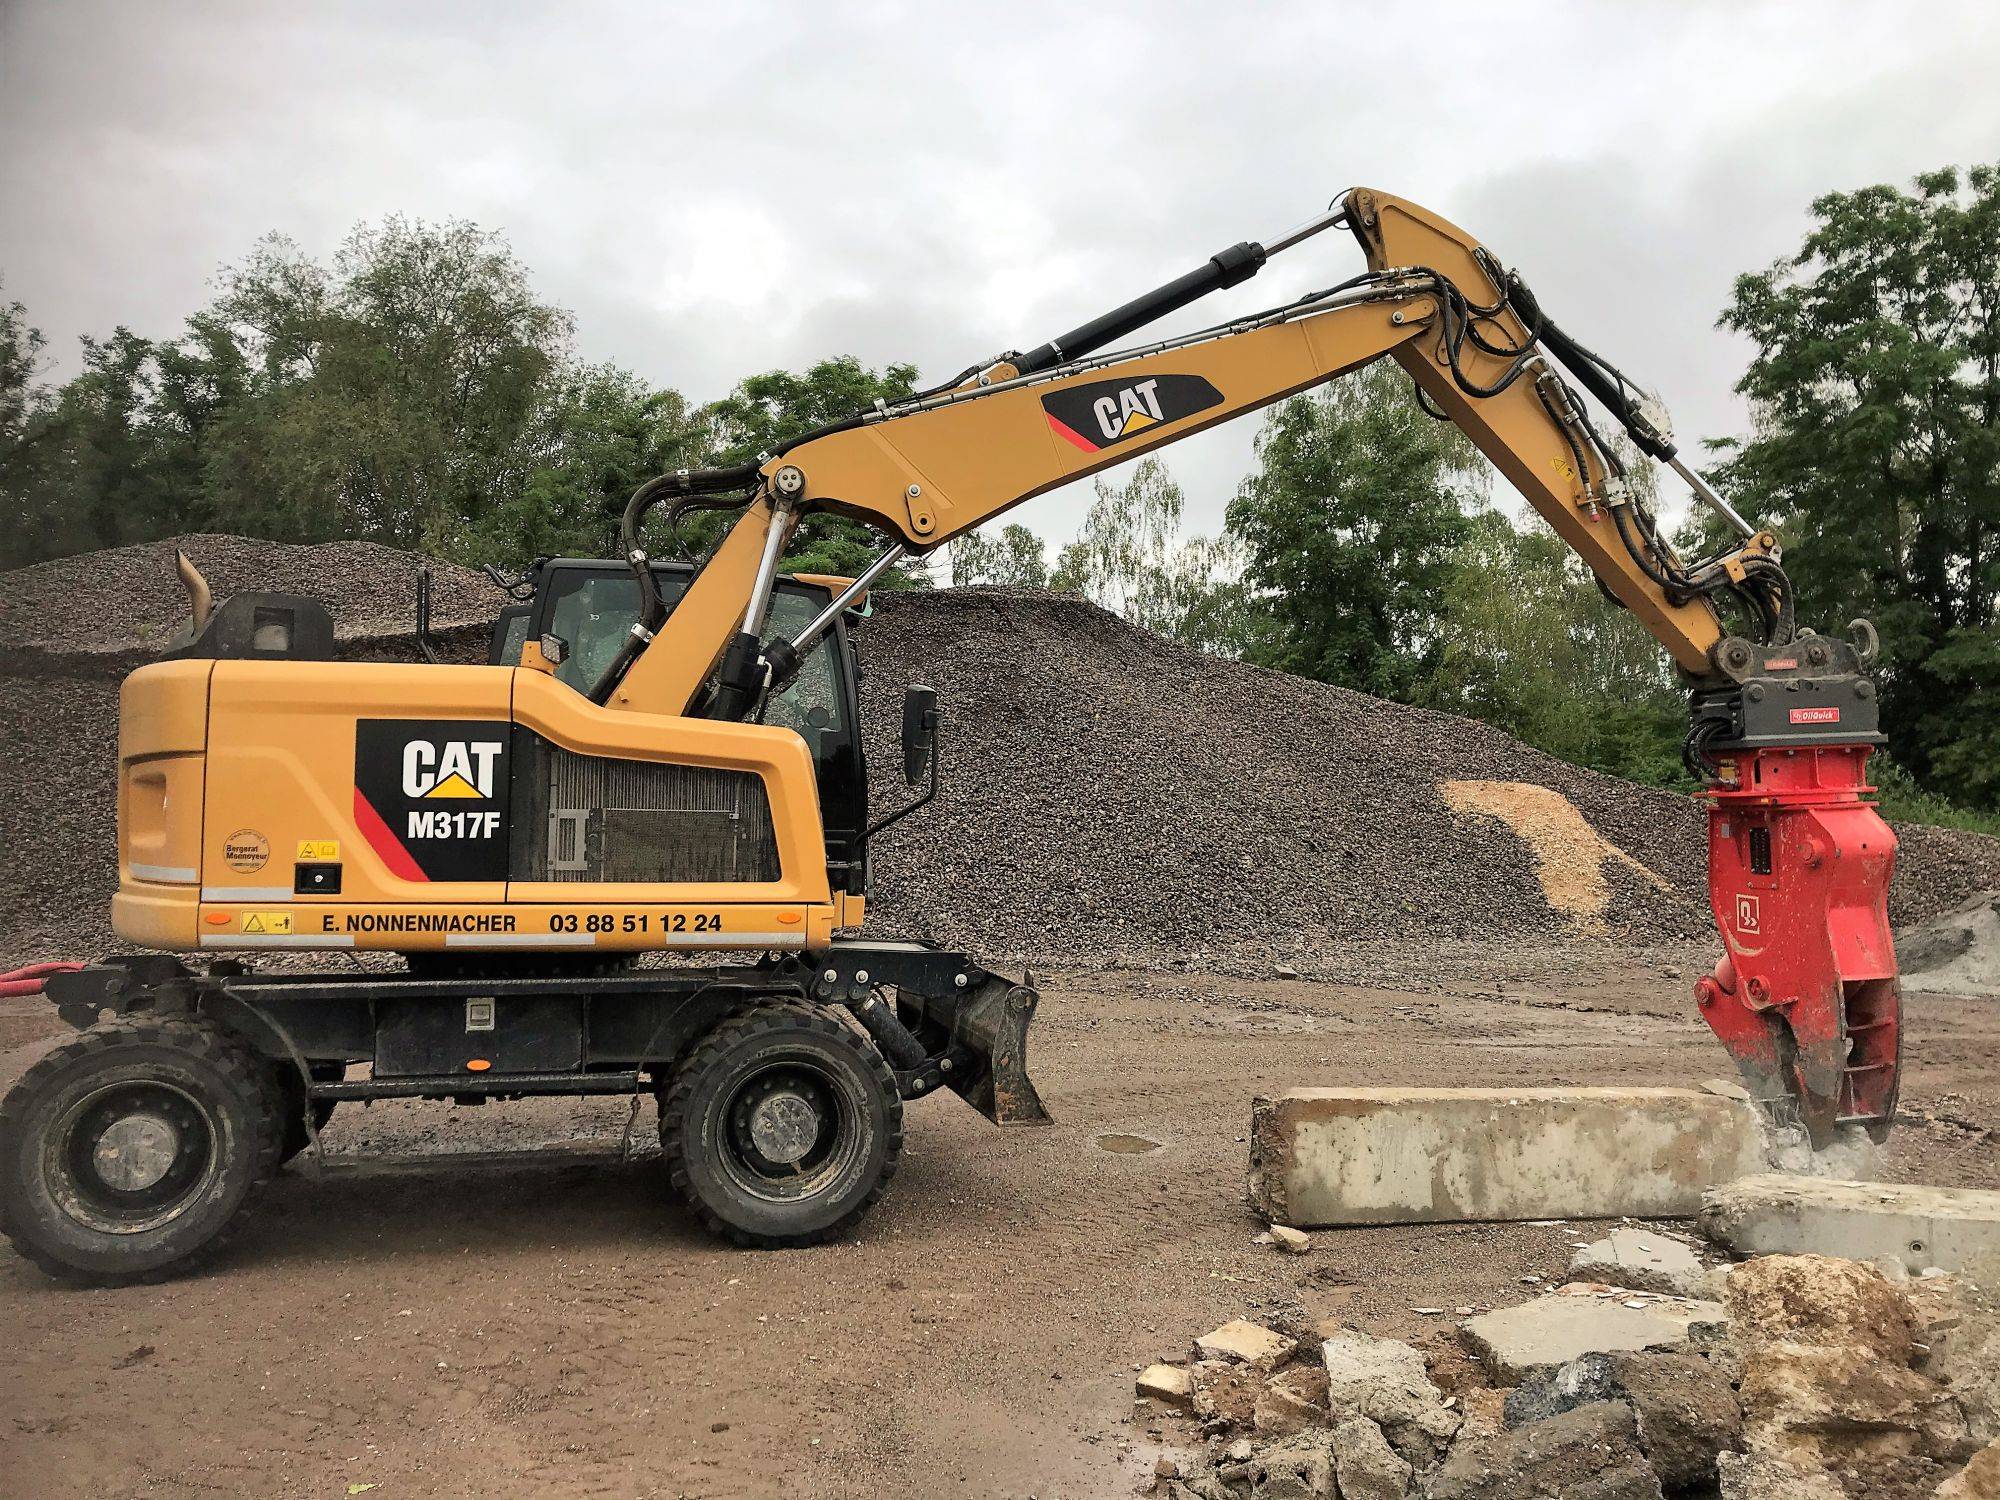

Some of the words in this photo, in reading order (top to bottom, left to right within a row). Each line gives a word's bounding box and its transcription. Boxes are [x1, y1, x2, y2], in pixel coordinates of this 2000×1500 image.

[1093, 378, 1164, 440] CAT
[1802, 711, 1833, 720] OilQuick
[402, 740, 502, 799] CAT
[407, 811, 500, 839] M317F
[226, 844, 258, 853] Bergerat
[322, 914, 340, 932] E.
[346, 914, 516, 932] NONNENMACHER
[549, 914, 578, 933] 03
[586, 914, 615, 933] 88
[622, 914, 648, 933] 51
[660, 914, 686, 932] 12
[694, 914, 722, 932] 24
